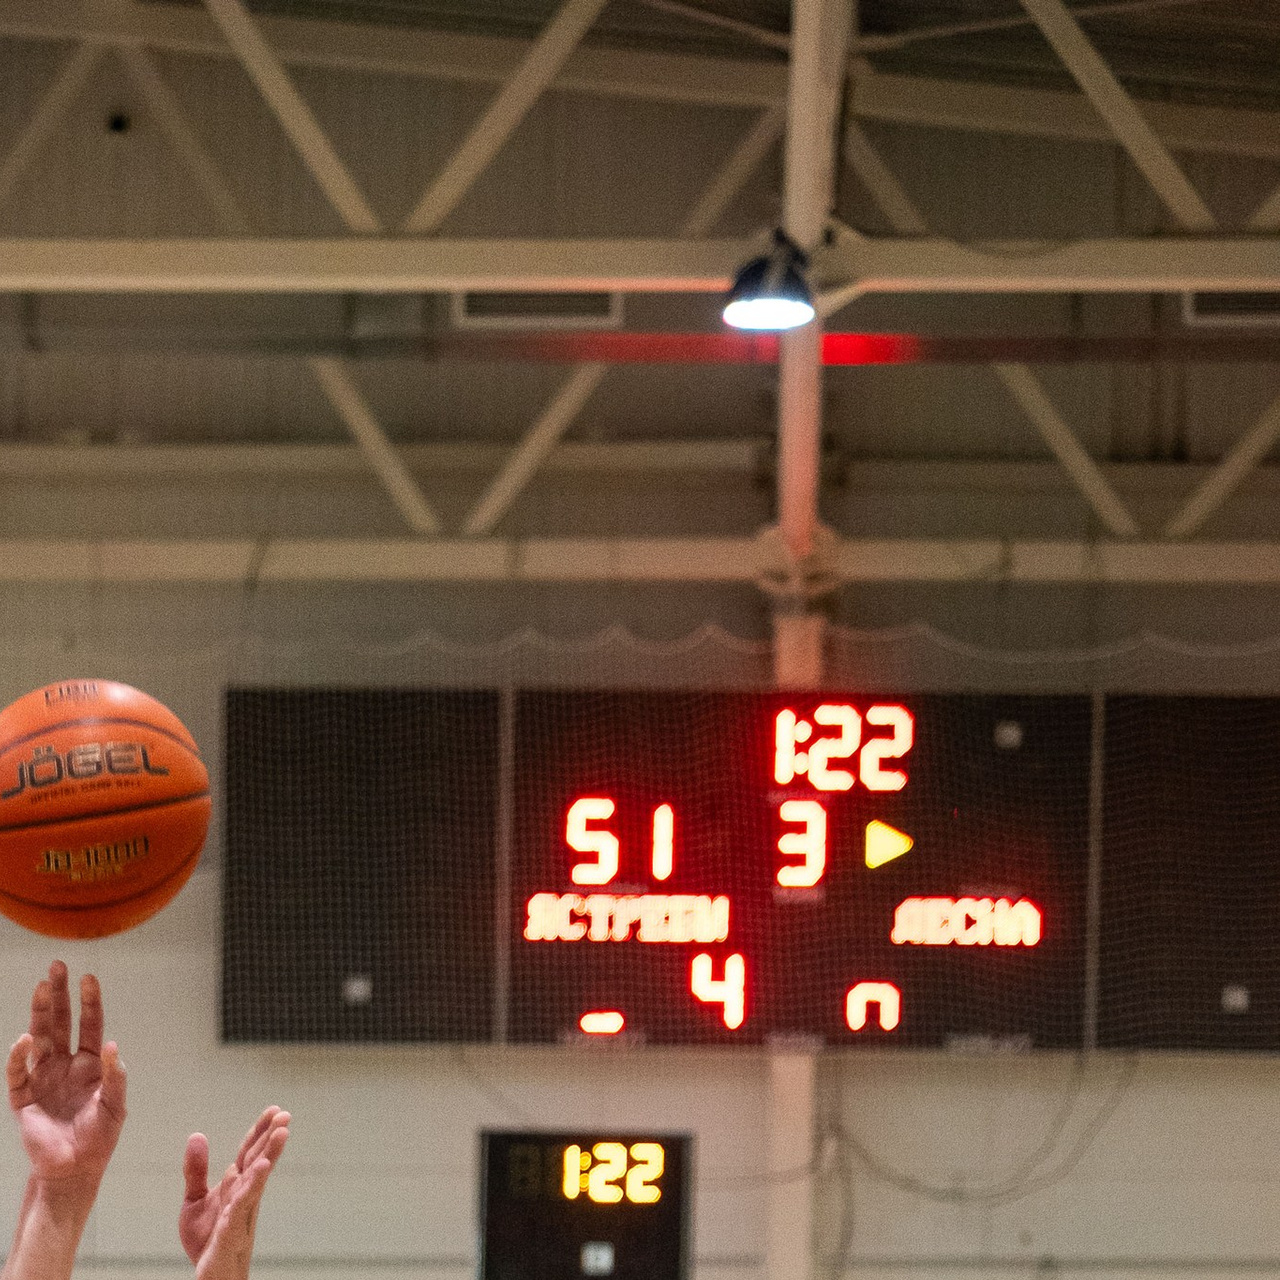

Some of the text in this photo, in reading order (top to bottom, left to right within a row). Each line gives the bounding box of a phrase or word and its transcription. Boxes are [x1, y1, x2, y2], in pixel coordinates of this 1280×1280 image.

[0, 742, 170, 800] JÖGEL
[772, 703, 914, 792] 1:22
[775, 798, 827, 888] 3
[690, 953, 745, 1030] 4
[563, 1142, 665, 1204] 1:22
